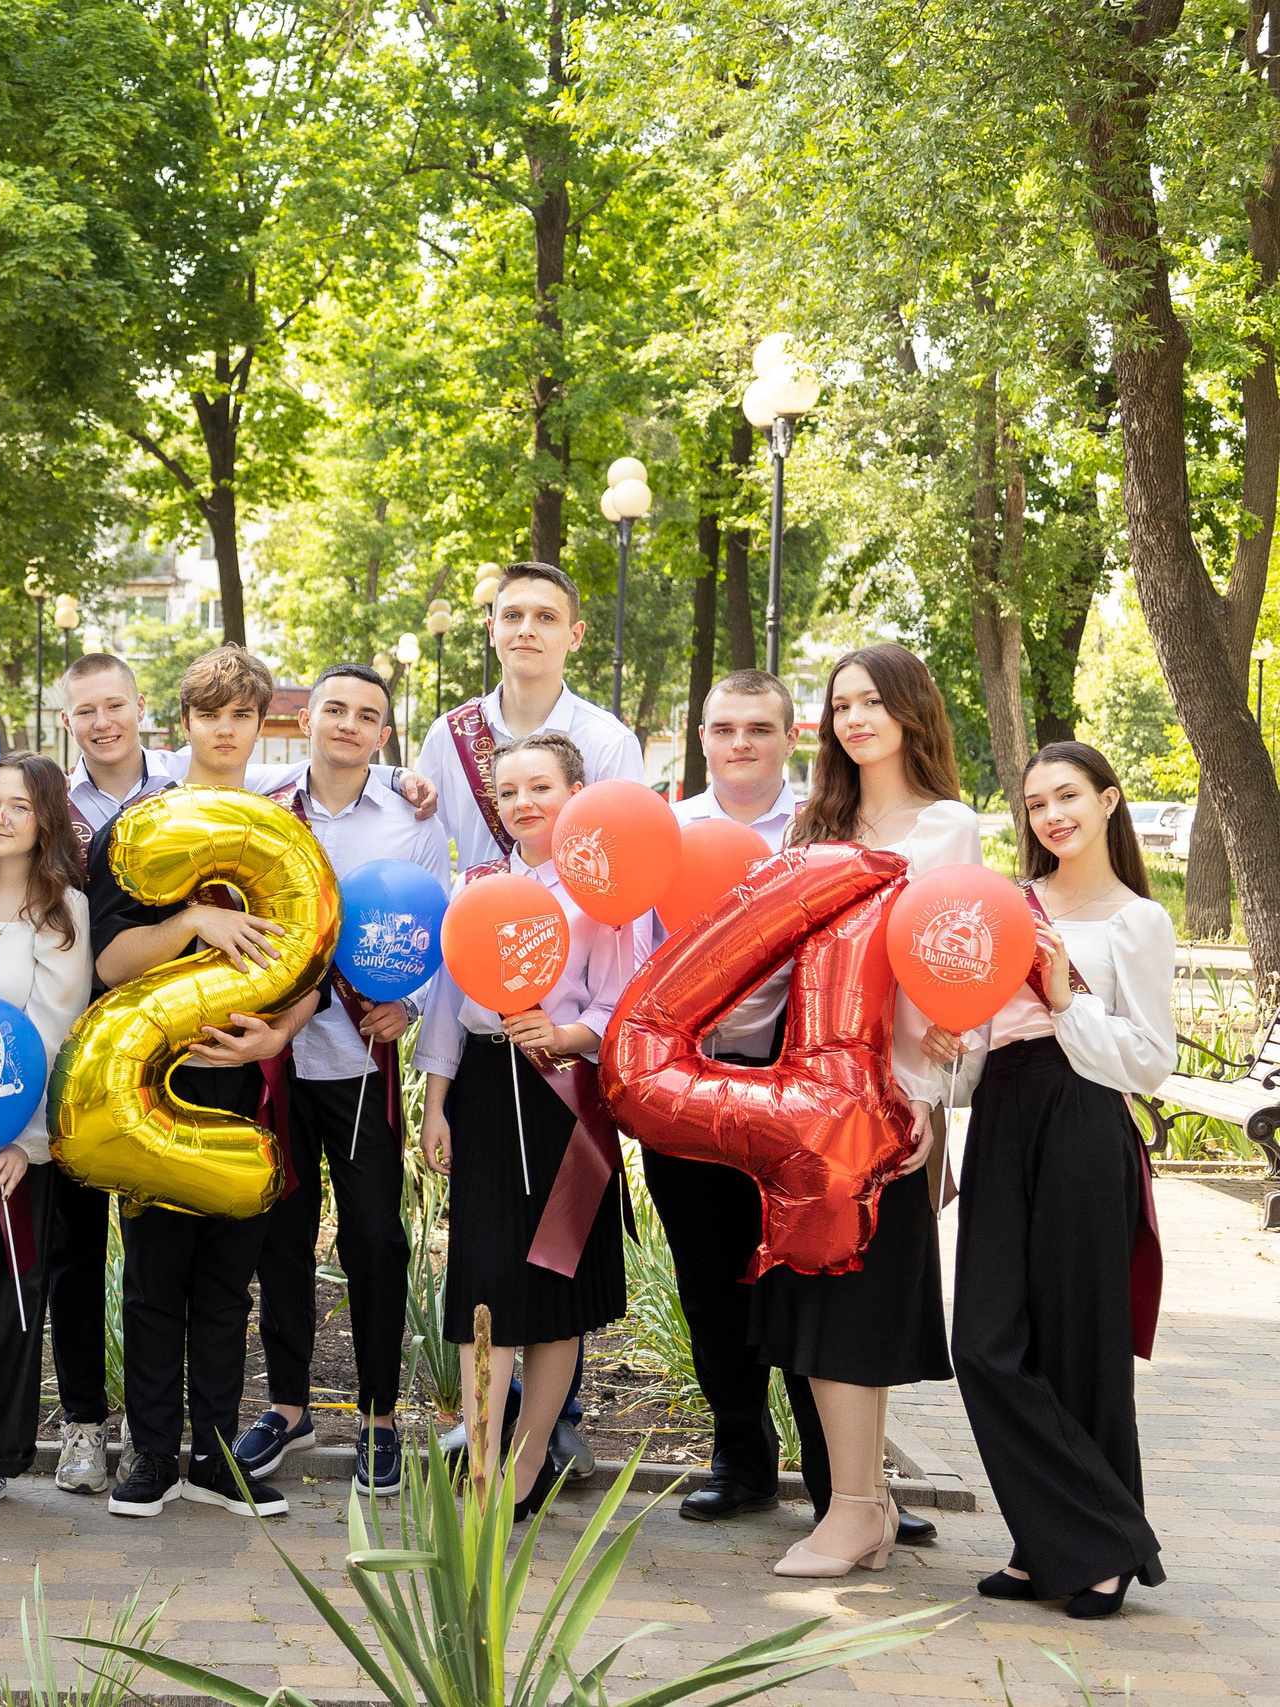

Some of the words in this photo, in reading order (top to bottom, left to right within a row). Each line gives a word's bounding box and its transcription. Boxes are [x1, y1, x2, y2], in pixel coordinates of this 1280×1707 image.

[561, 864, 605, 889] ВЫПУСКНИК
[500, 943, 518, 961] До
[516, 926, 556, 959] ШКОЛА!
[352, 954, 426, 975] ВЫПУСКНОЙ
[924, 947, 984, 973] ВЫПУСКНИК
[52, 785, 345, 1219] 2
[597, 841, 917, 1279] 4
